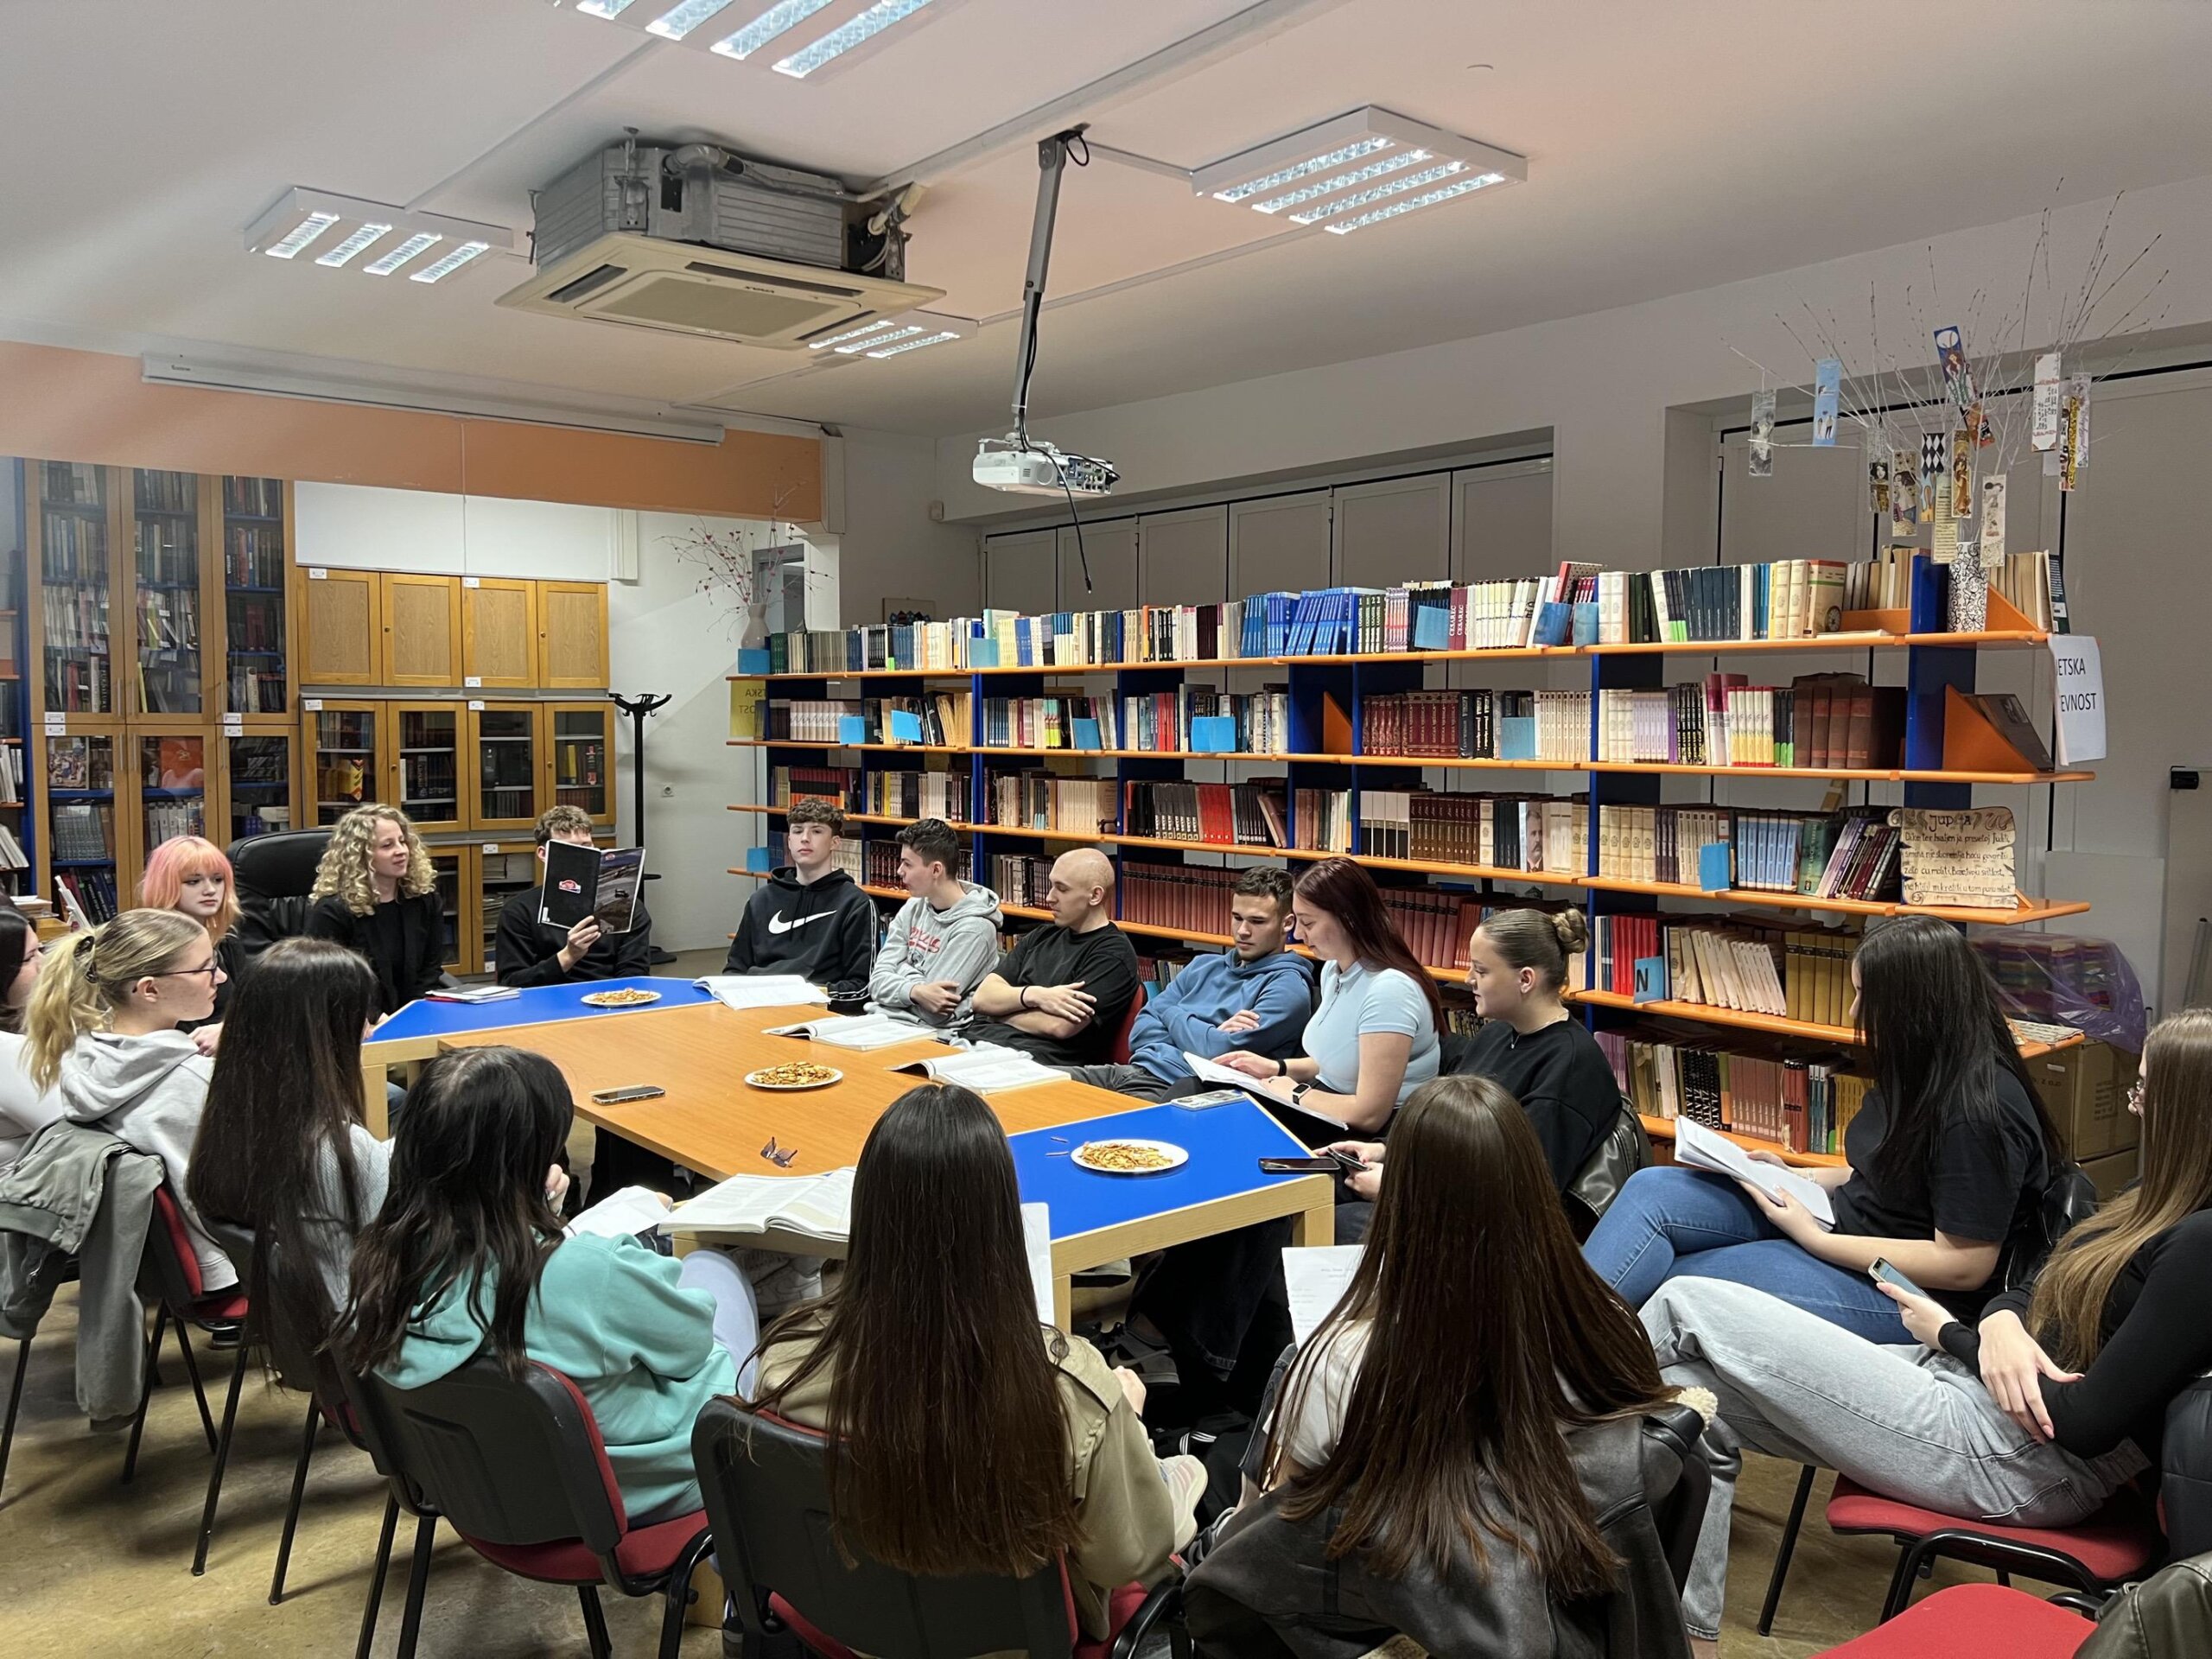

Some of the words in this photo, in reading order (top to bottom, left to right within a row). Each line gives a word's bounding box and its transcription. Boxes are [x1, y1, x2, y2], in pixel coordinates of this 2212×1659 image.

[1636, 968, 1649, 993] N
[1685, 1087, 1694, 1121] ZLATO
[1694, 1088, 1703, 1124] ZLATO
[1702, 1090, 1712, 1126] ZLATO
[1711, 1091, 1719, 1128] ZLATO
